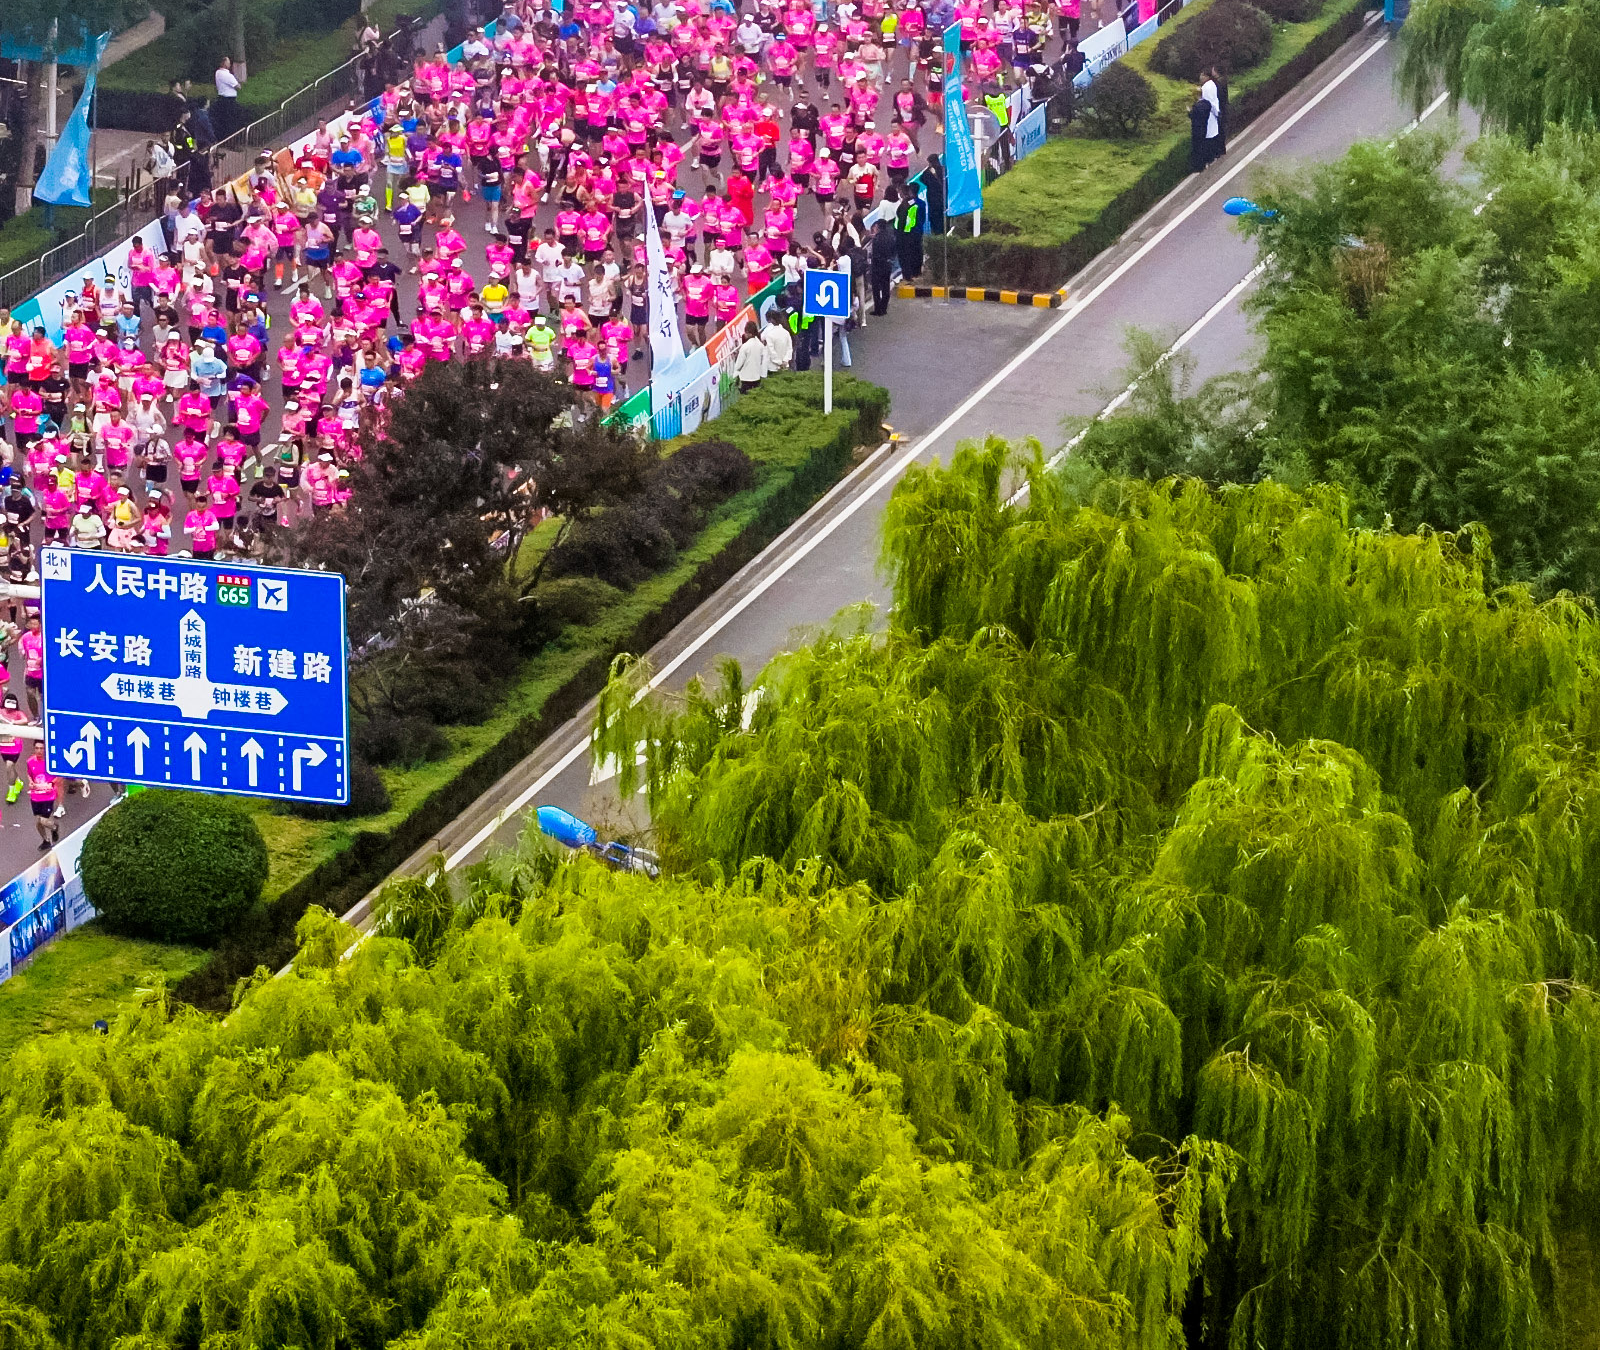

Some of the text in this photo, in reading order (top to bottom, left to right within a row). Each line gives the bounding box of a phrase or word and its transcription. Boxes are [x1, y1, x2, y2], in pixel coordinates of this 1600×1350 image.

[45, 552, 68, 568] 北 N
[84, 563, 209, 604] 人民中路
[218, 586, 250, 605] G65
[54, 627, 153, 667] 长安路
[184, 618, 202, 680] 长城南路
[233, 644, 333, 684] 新建路
[116, 677, 176, 701] 钟楼巷
[212, 687, 273, 710] 钟楼巷
